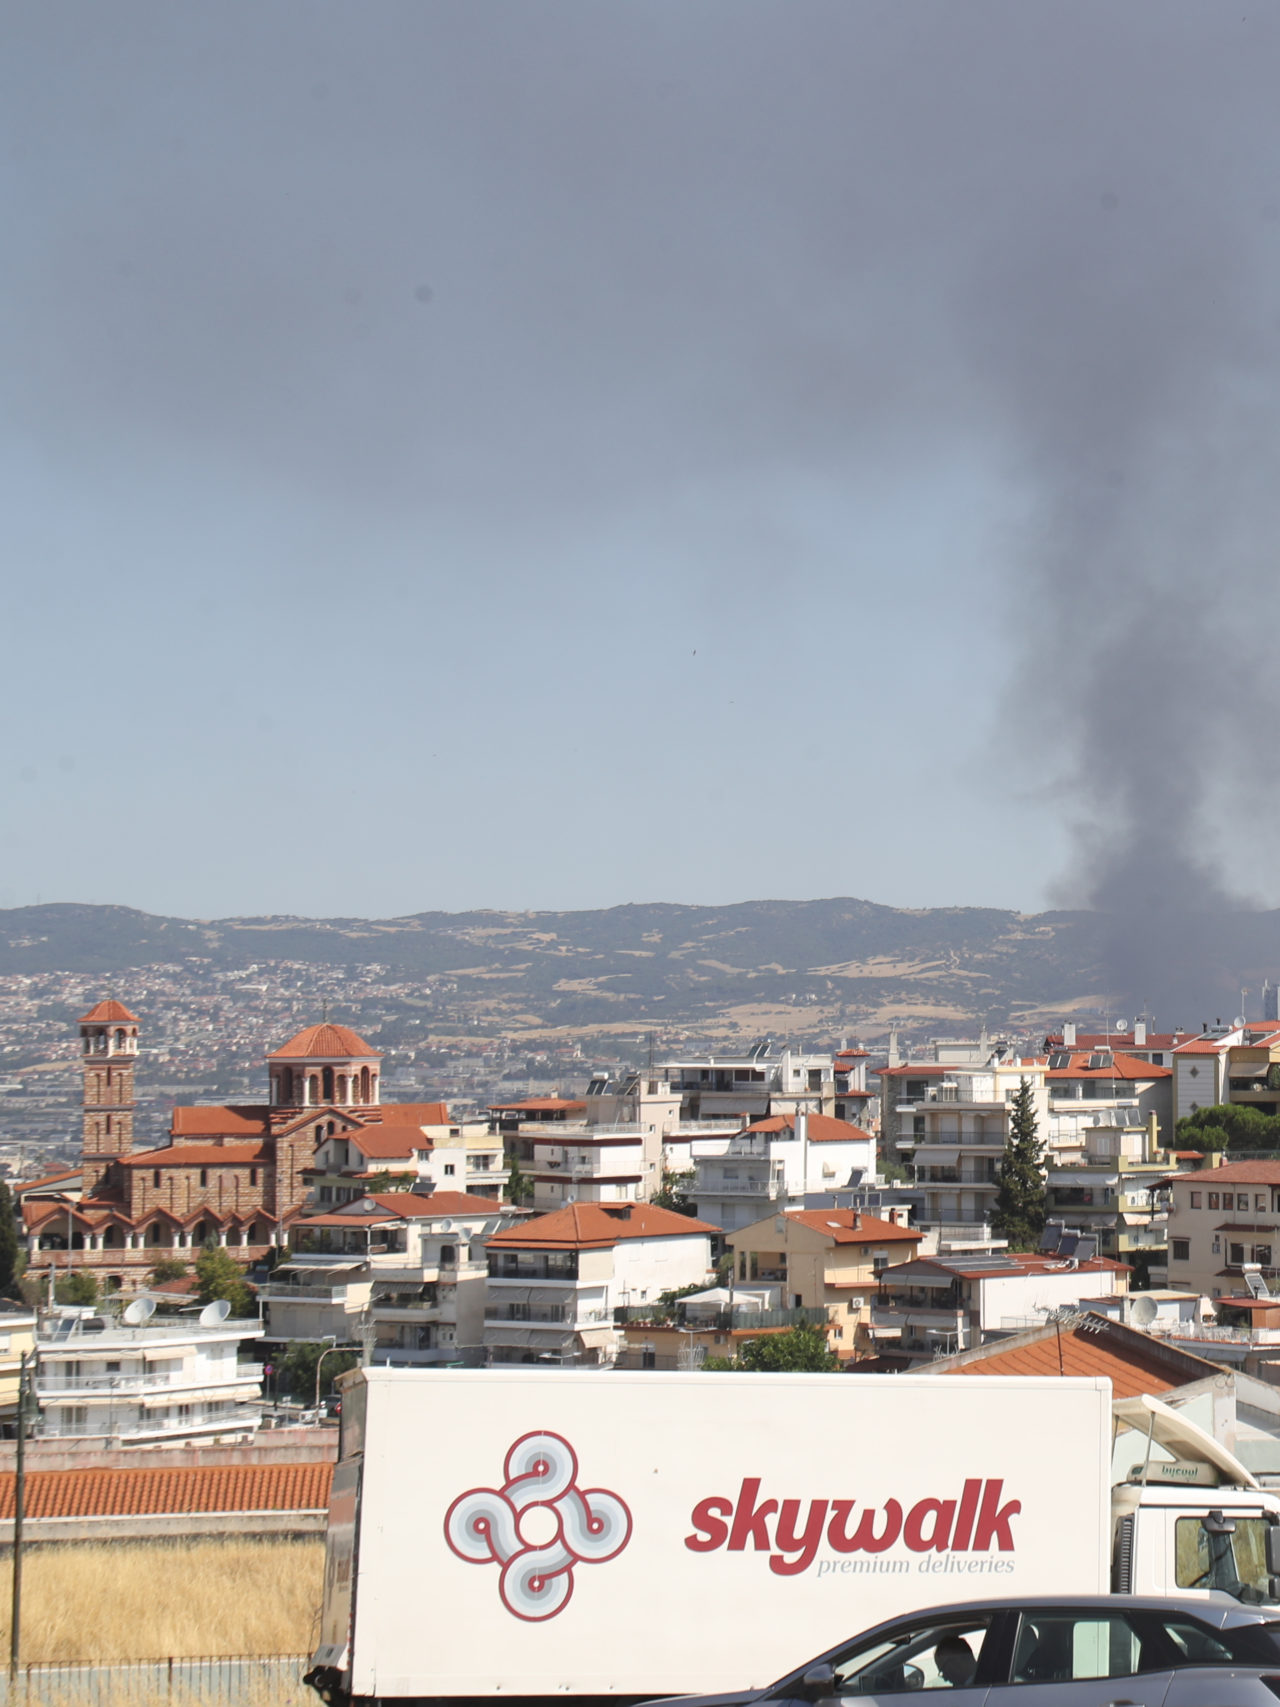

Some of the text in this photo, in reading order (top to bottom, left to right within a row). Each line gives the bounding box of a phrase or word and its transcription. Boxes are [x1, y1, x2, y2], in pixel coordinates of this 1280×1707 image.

[684, 1477, 1022, 1577] skywalk
[816, 1554, 1016, 1578] premium deliveries
